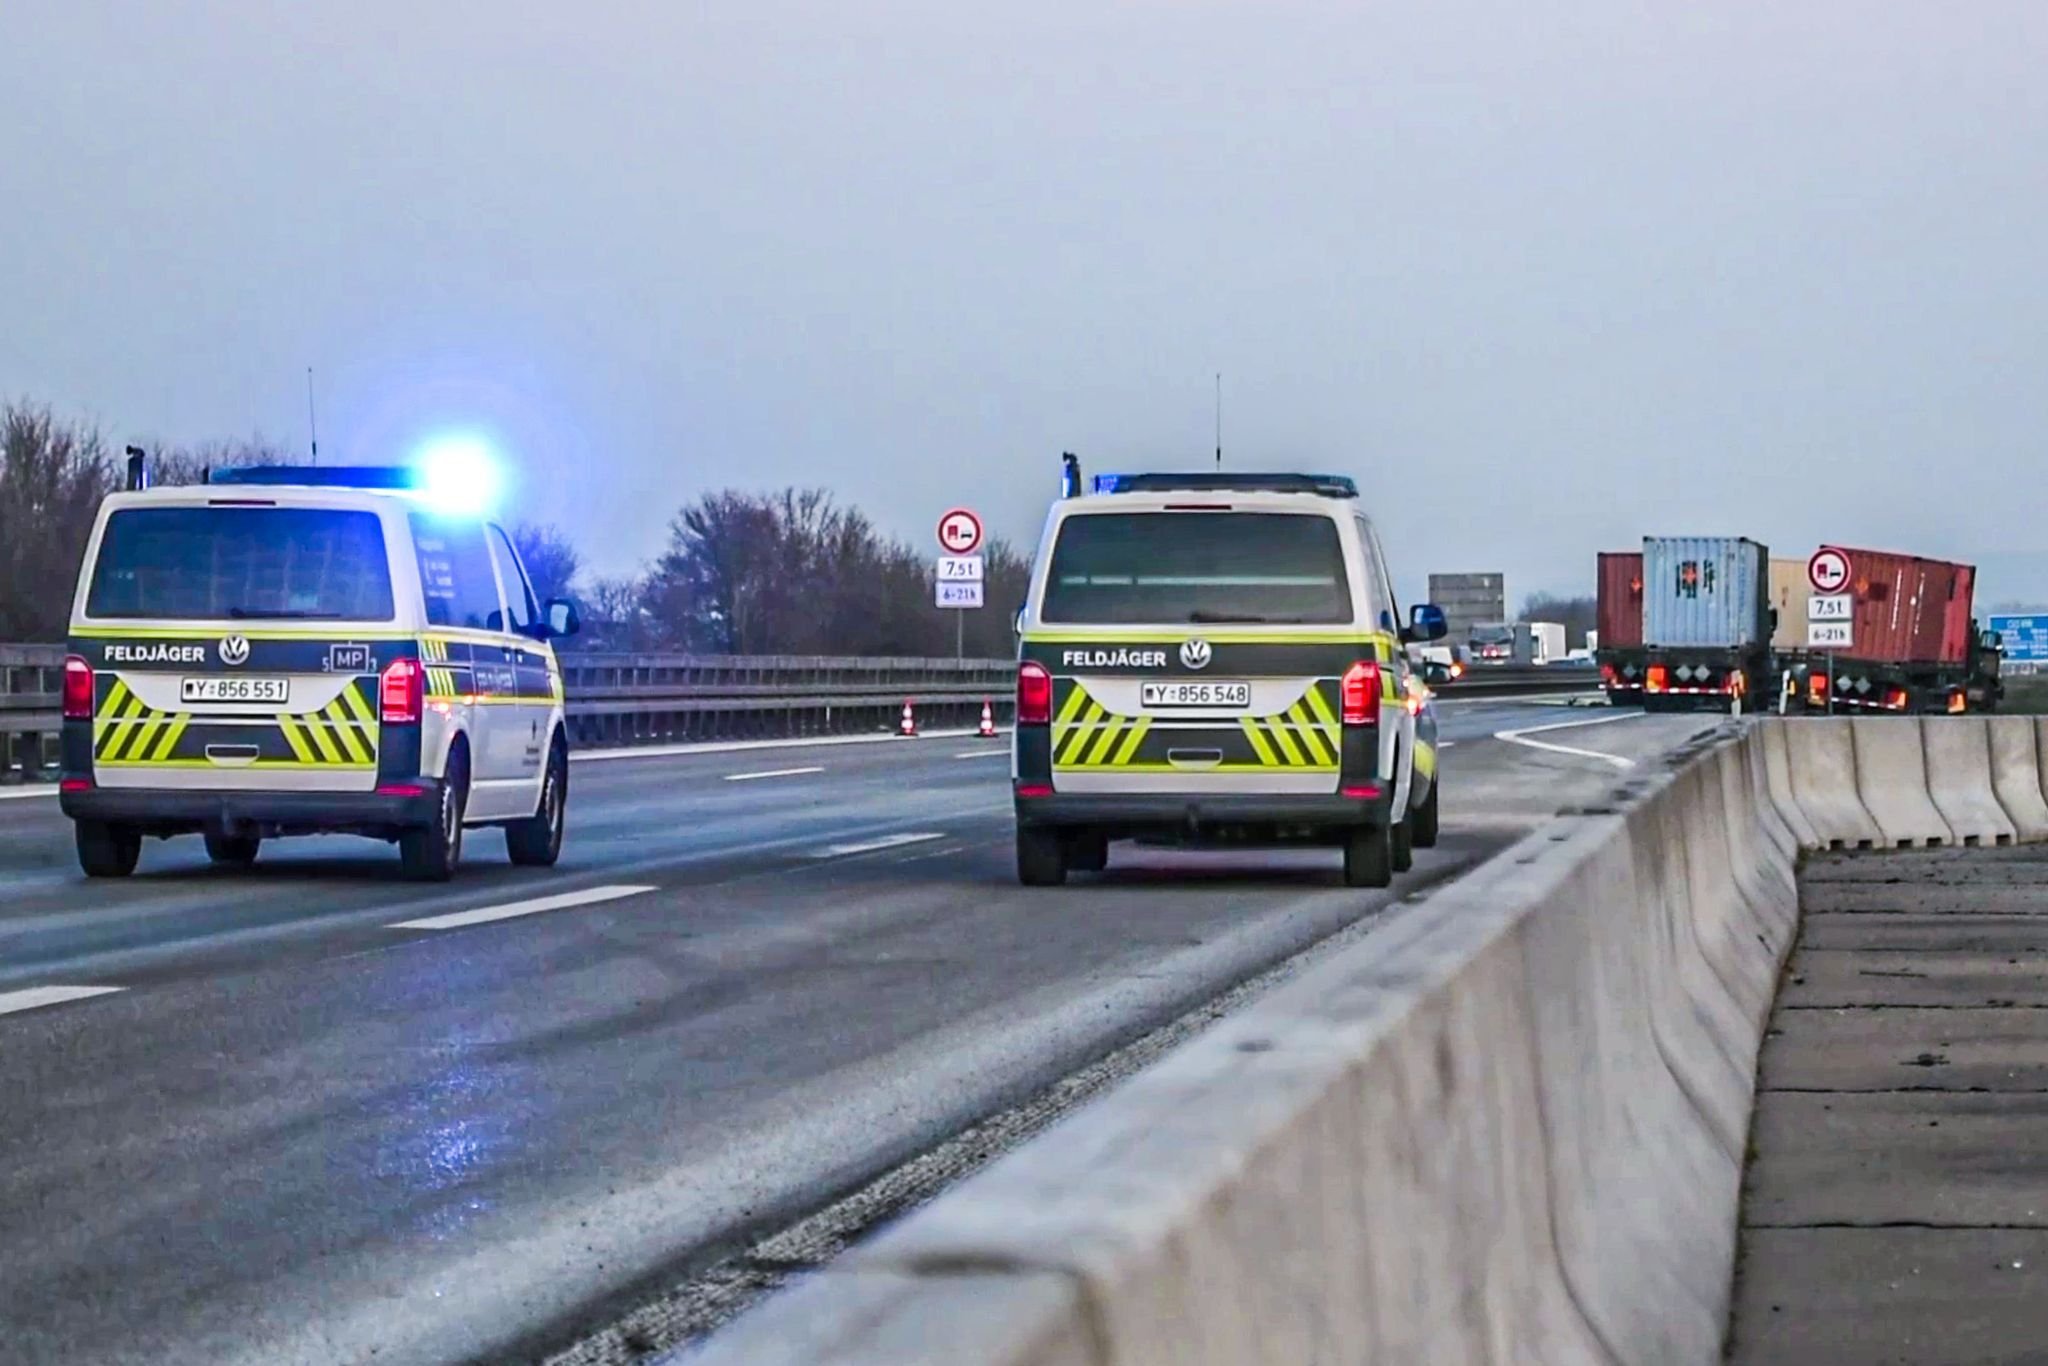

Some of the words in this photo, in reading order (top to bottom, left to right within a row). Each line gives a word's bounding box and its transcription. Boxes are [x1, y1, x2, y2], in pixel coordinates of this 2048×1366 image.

[104, 643, 205, 662] FELDJÄGER
[336, 650, 364, 667] MP
[1063, 648, 1167, 667] FELDJÄGER
